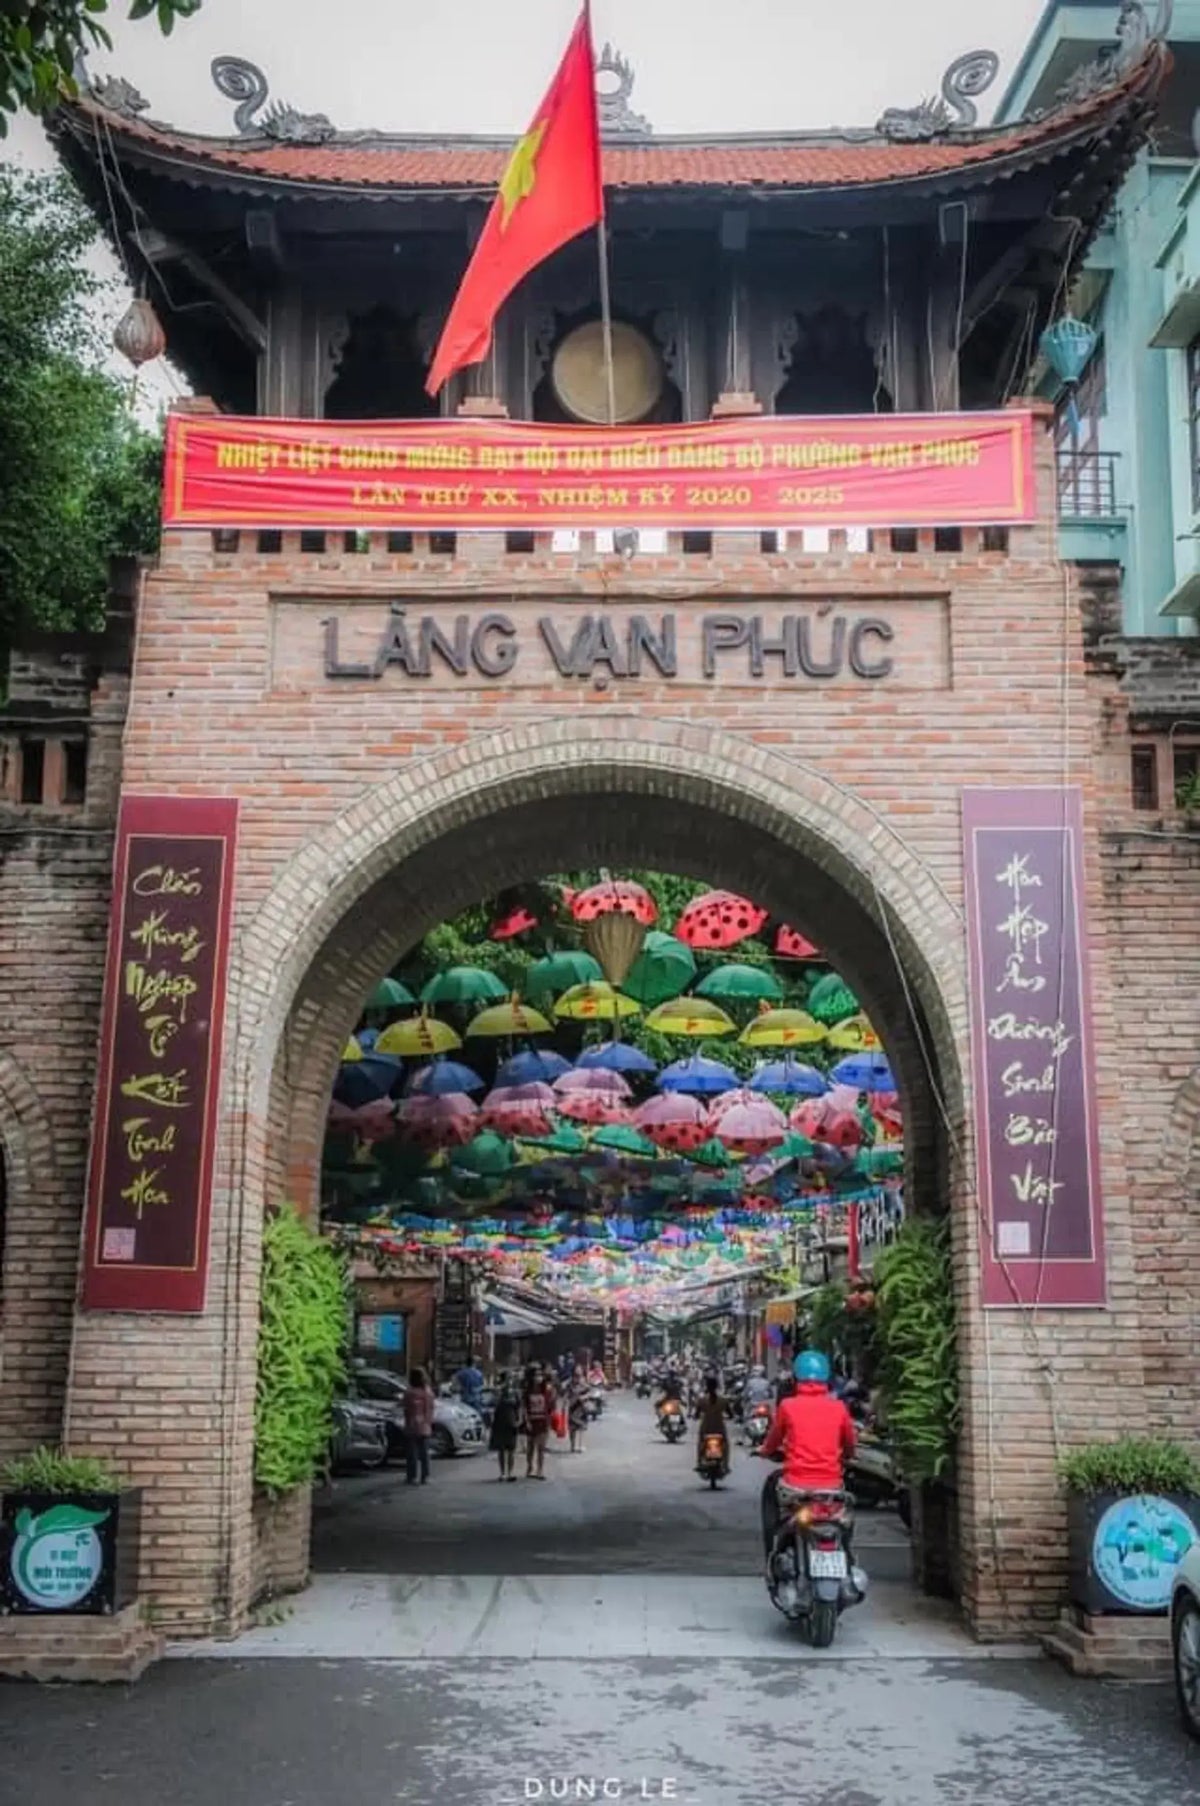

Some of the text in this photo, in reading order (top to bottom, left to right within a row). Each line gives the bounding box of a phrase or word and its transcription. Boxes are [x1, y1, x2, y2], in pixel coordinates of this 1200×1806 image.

[217, 437, 279, 475] NHIỆT
[735, 440, 763, 475] BỘ
[421, 482, 473, 506] THỨ
[482, 487, 528, 509] XX,
[687, 486, 752, 506] 2020
[778, 485, 845, 505] 2025
[322, 603, 894, 691] LÀNG VẠN PHÚC
